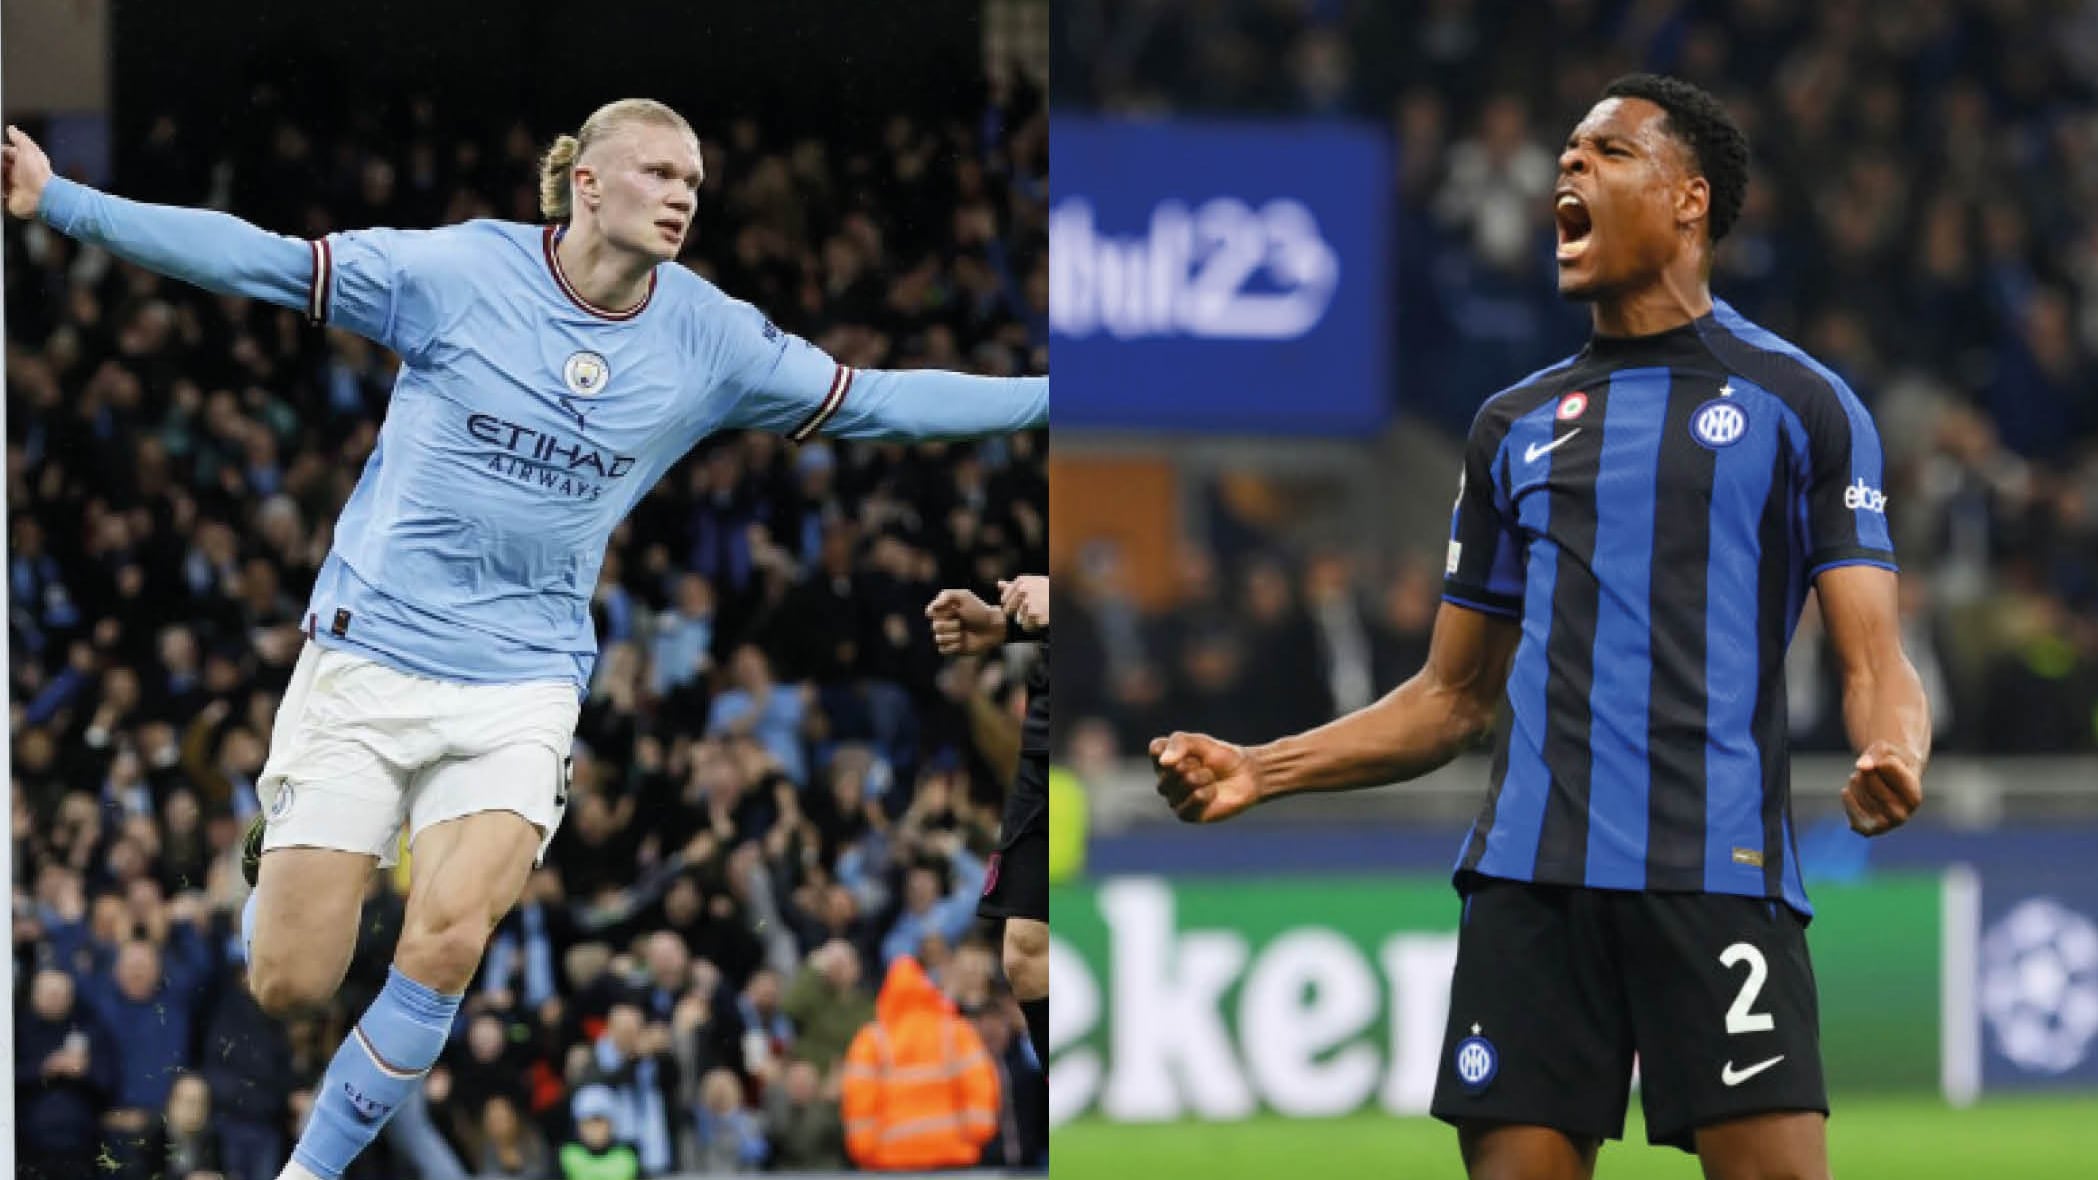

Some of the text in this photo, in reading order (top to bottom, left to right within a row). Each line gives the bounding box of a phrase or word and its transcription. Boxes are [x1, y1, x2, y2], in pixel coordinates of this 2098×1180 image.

[466, 413, 637, 478] ETIHAD
[487, 453, 602, 501] AIRWAYS
[1718, 942, 1776, 1035] 2
